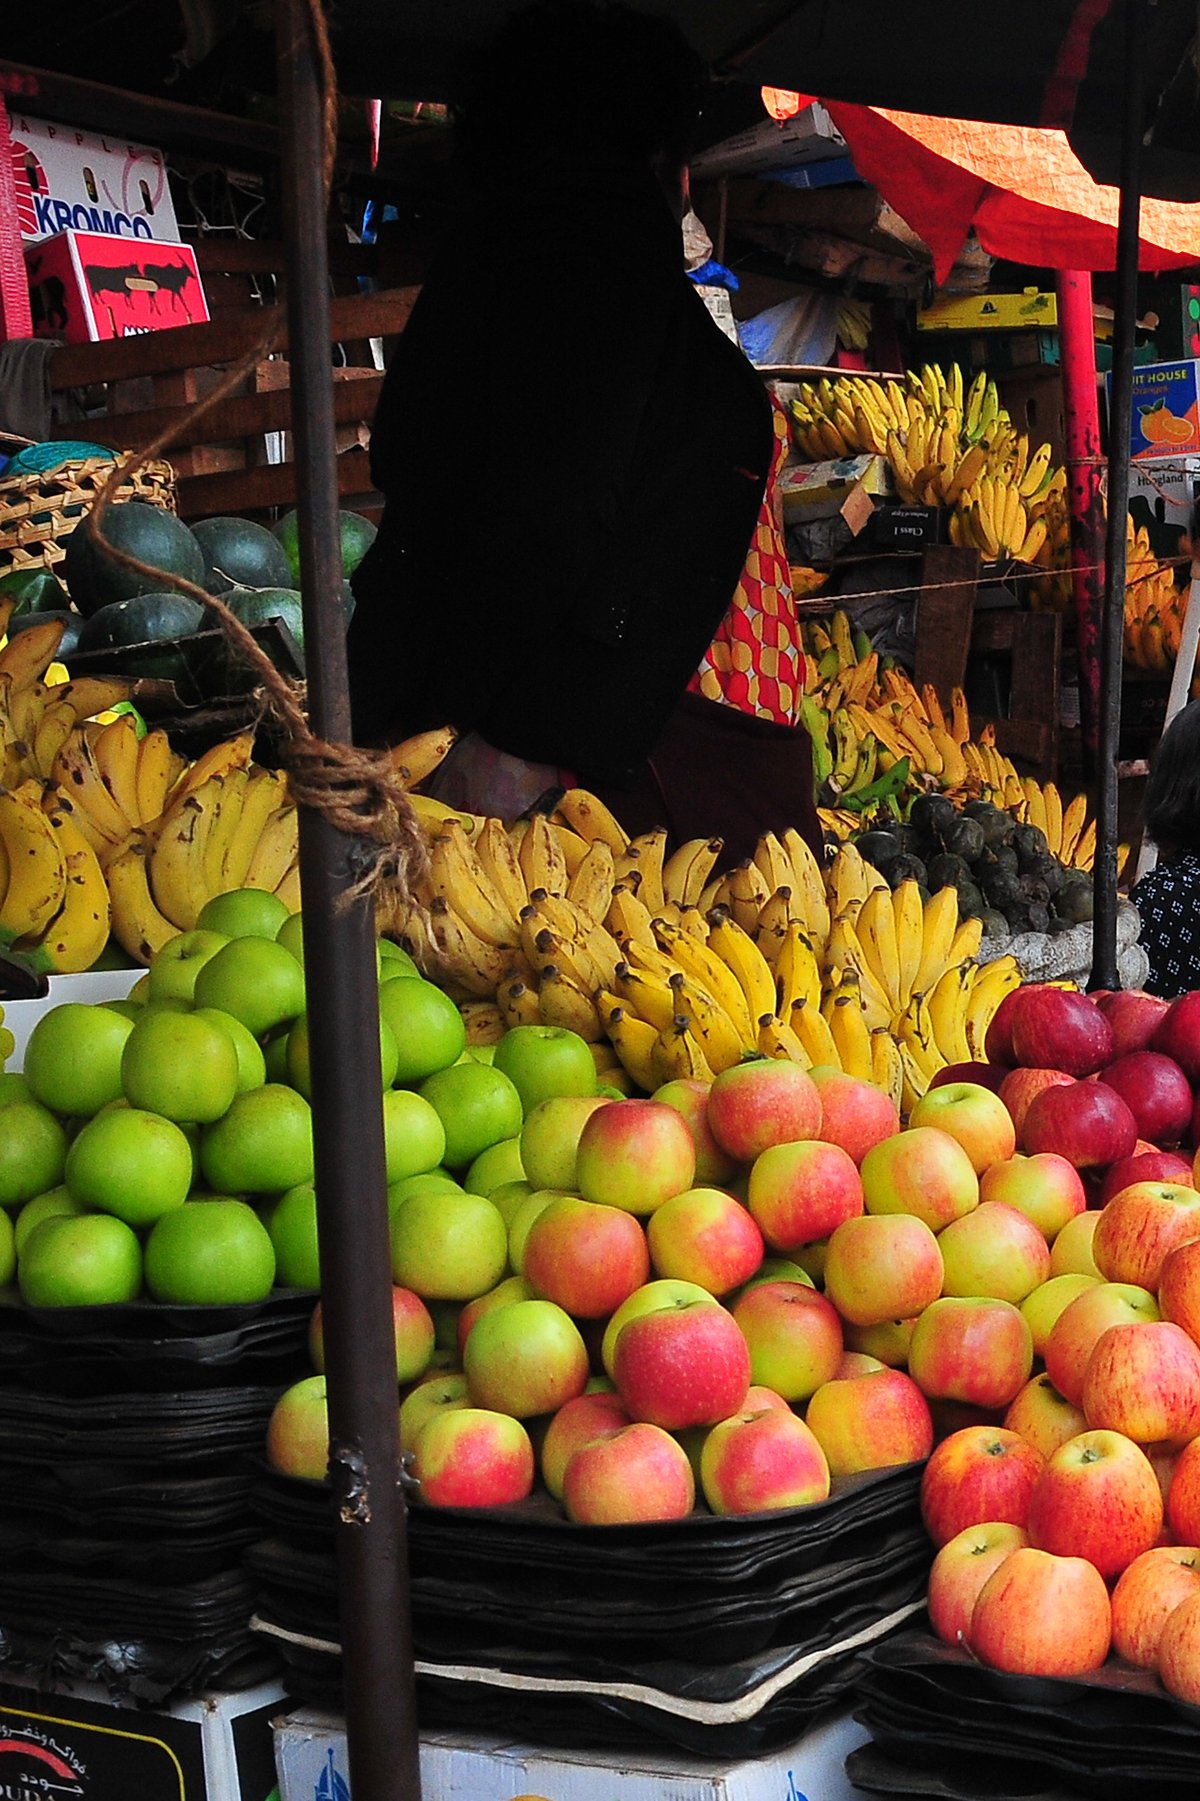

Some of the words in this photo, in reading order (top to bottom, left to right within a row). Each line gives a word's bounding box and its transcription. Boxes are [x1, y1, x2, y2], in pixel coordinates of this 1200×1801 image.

[20, 119, 162, 165] APPLES
[33, 195, 153, 239] KROMCO
[1147, 369, 1188, 383] HOUSE
[1137, 473, 1184, 487] Hoogland
[900, 527, 923, 536] Class
